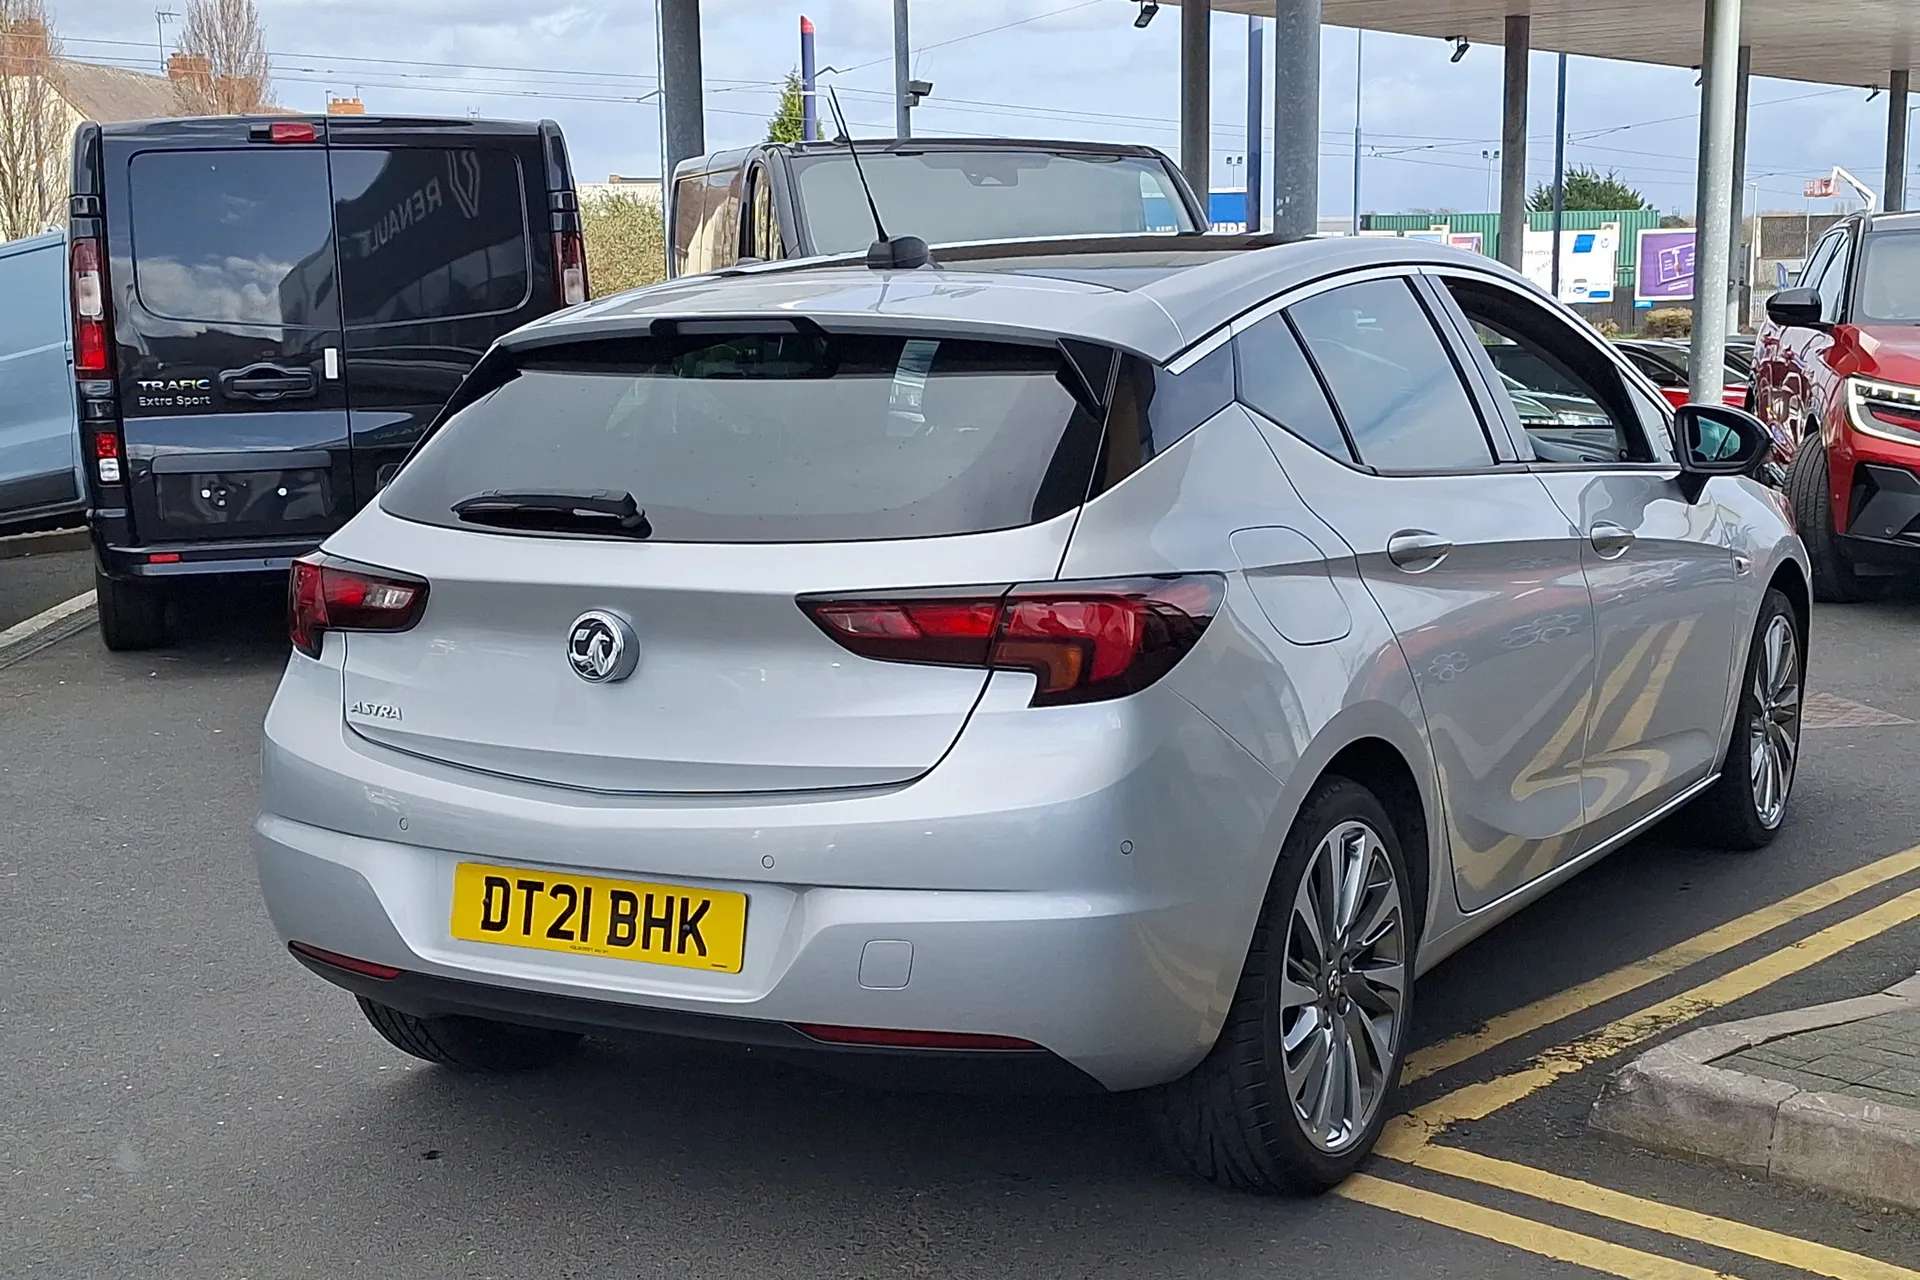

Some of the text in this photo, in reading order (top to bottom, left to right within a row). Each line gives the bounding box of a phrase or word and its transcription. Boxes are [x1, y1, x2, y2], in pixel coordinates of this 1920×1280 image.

[137, 379, 211, 391] TRAFIC
[138, 395, 211, 408] Extra Sport
[350, 701, 403, 721] ASTRA
[480, 875, 711, 957] DT21 BHK
